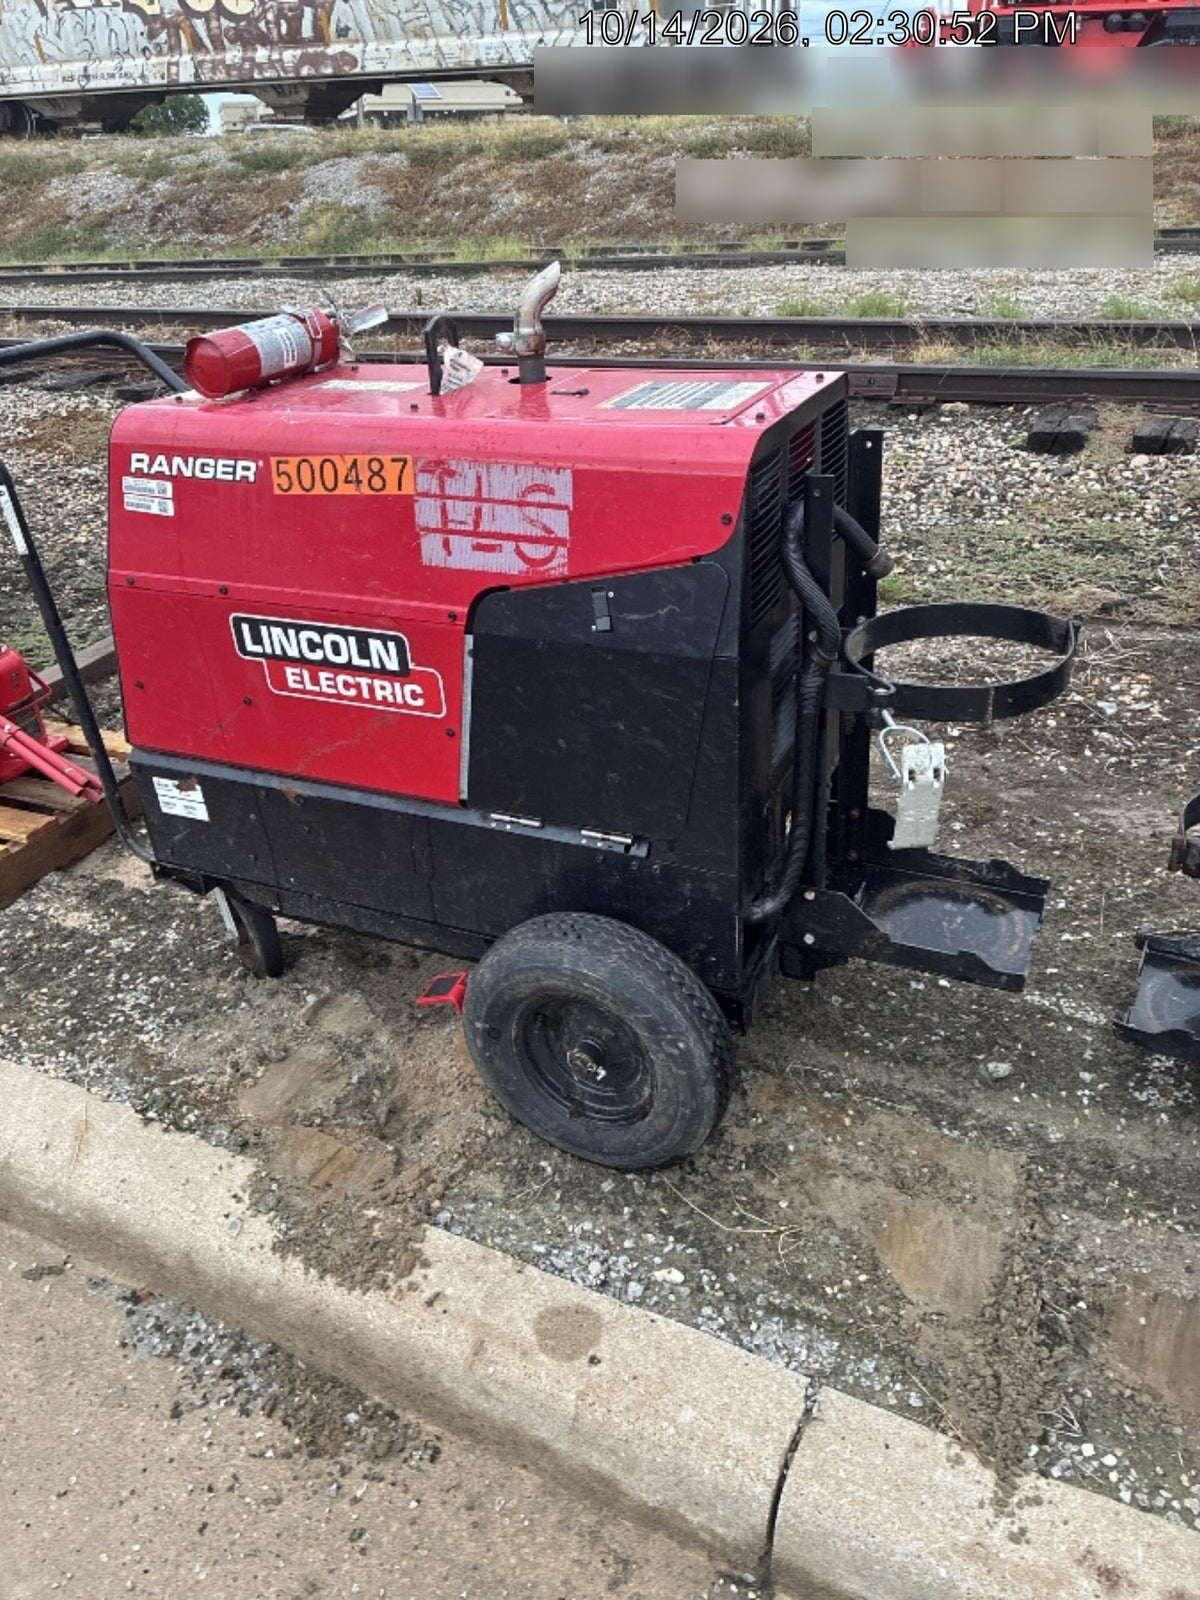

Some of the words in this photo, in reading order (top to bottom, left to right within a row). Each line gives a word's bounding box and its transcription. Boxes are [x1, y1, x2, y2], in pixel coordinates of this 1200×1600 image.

[130, 453, 258, 483] RANGER
[276, 457, 409, 493] 500487
[241, 623, 401, 671] LINCOLN
[285, 666, 425, 707] ELECTRIC
